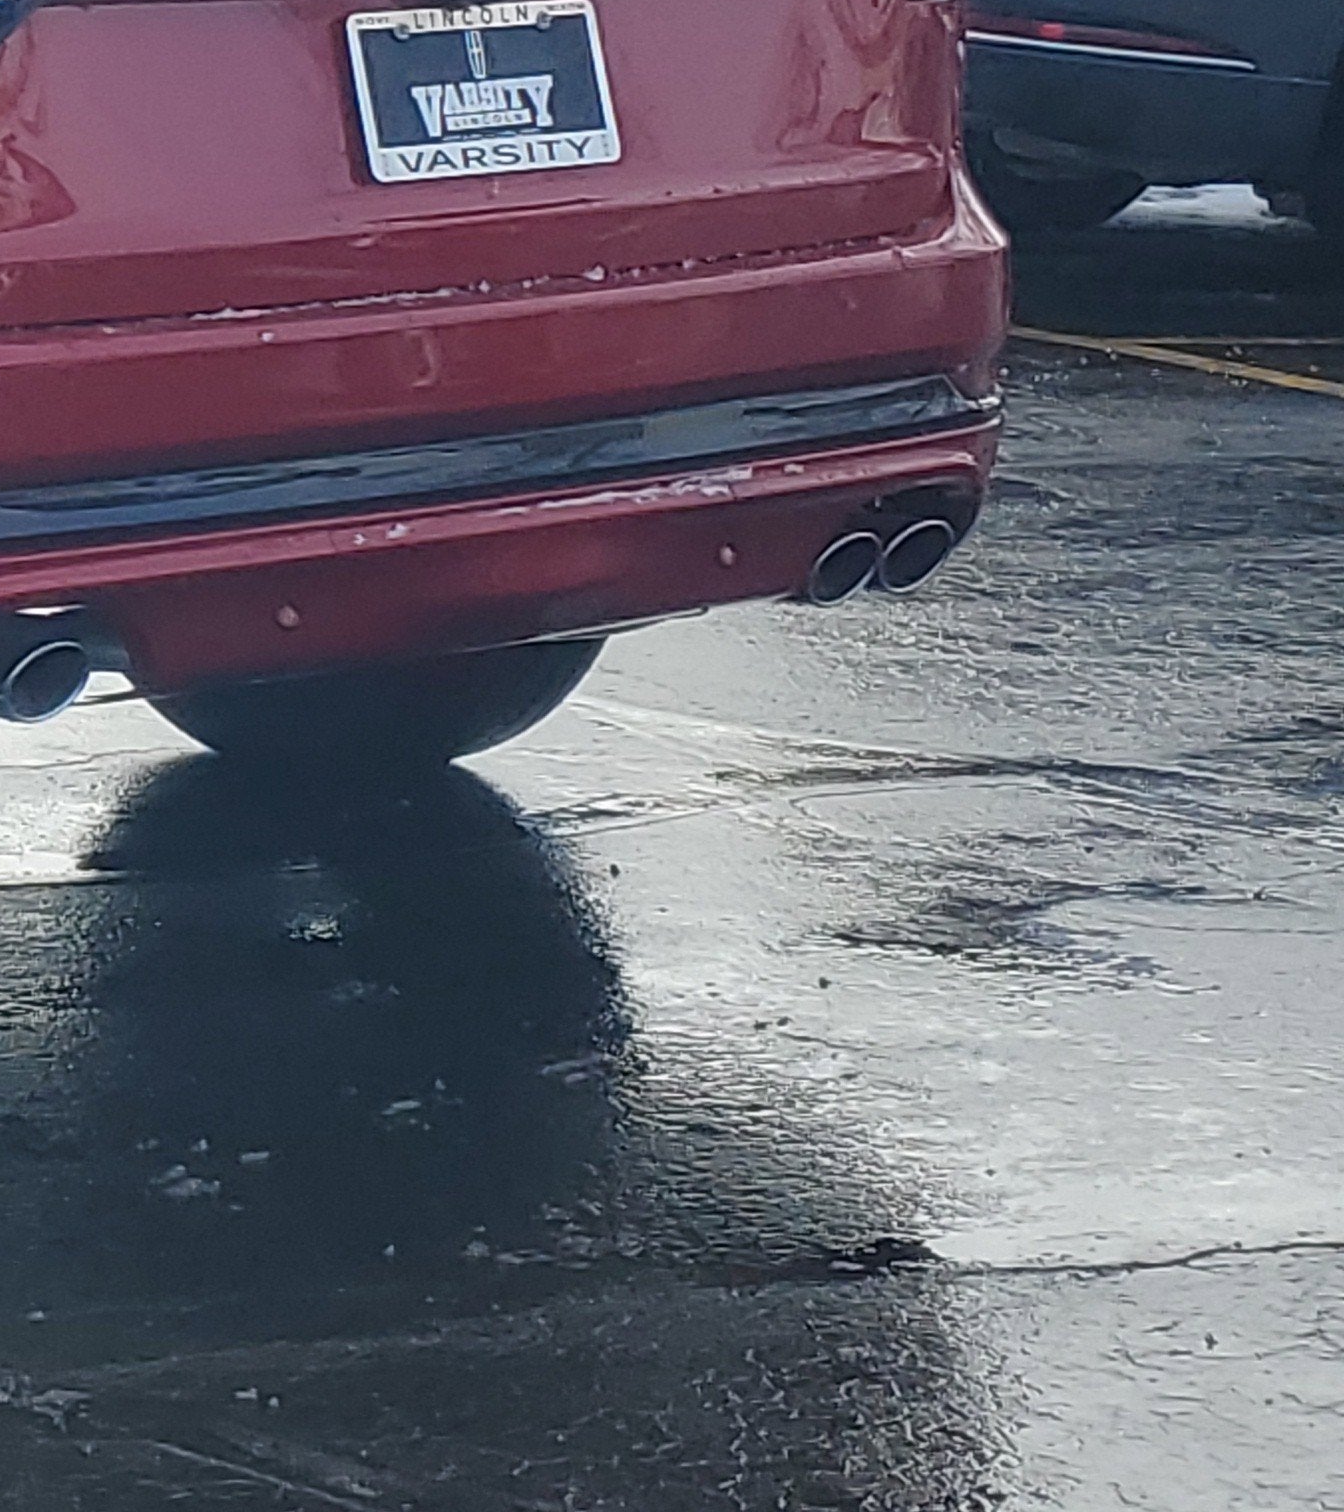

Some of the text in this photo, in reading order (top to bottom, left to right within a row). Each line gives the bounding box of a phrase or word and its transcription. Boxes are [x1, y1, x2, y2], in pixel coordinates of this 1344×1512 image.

[413, 5, 529, 30] LINCOLN
[411, 74, 554, 138] VARSITY
[398, 137, 592, 174] VARSITY
